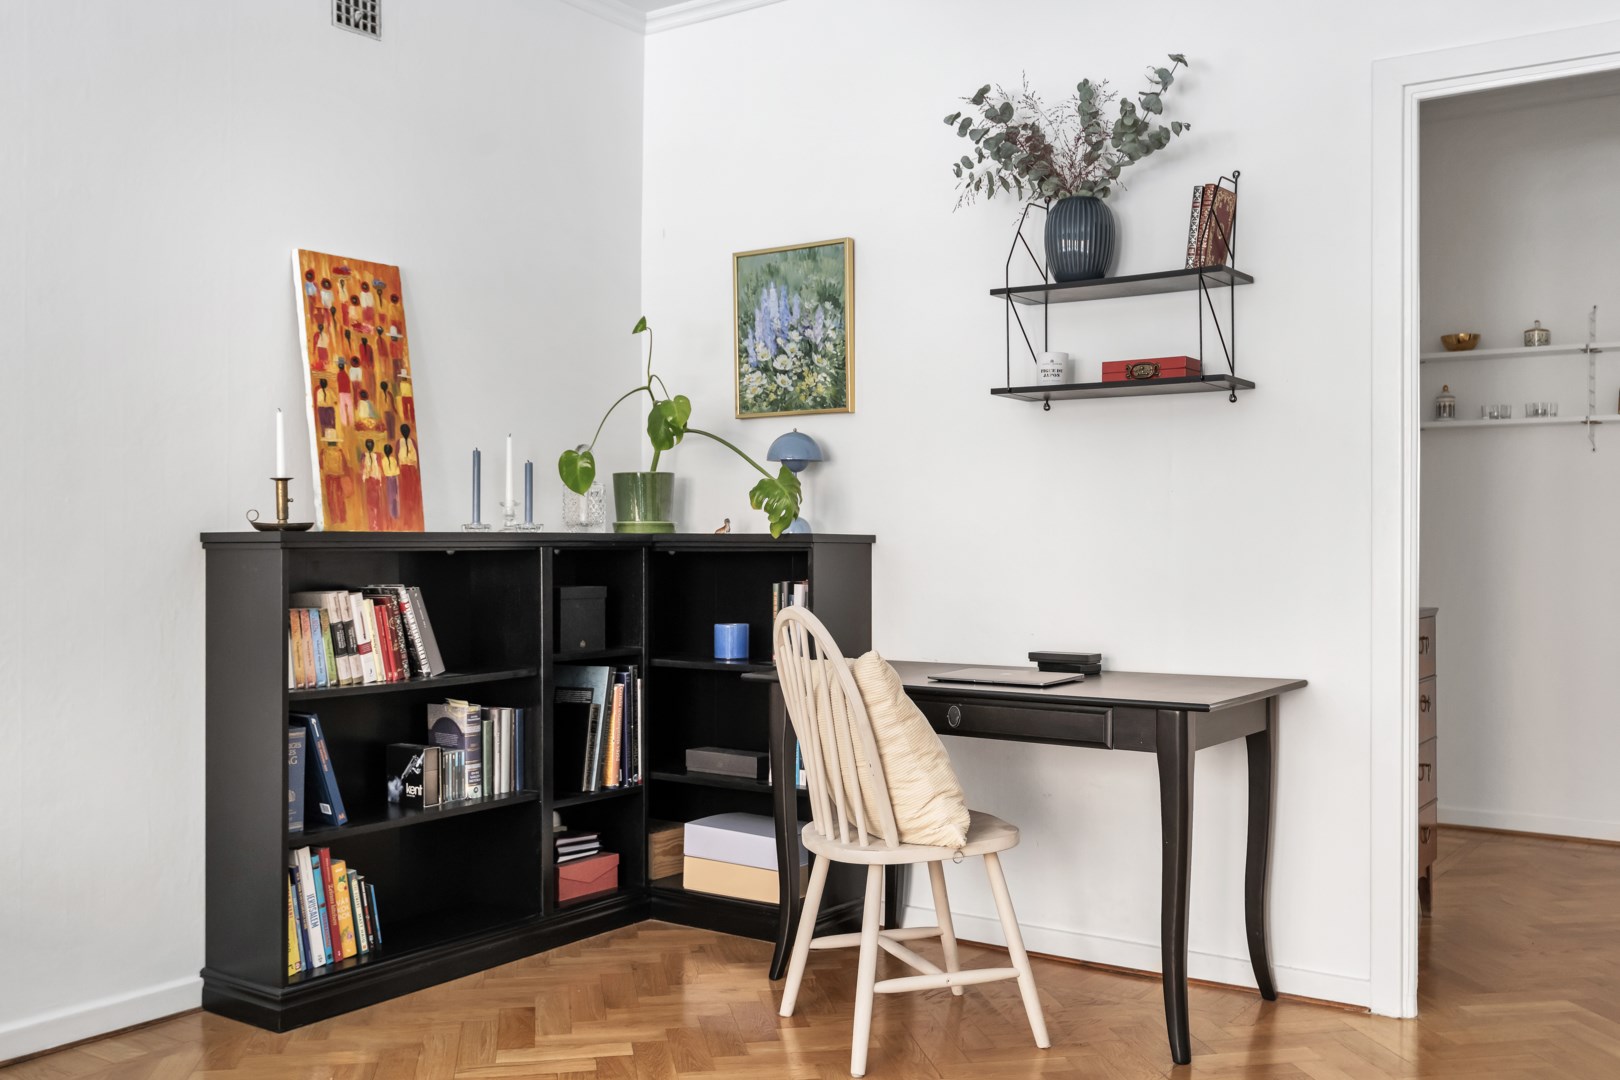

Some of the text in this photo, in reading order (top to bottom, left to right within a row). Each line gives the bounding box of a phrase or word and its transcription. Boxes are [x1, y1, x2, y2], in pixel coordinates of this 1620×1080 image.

[405, 602, 415, 623] DYLAN
[406, 783, 423, 796] kent
[307, 894, 319, 928] JERUSALEM
